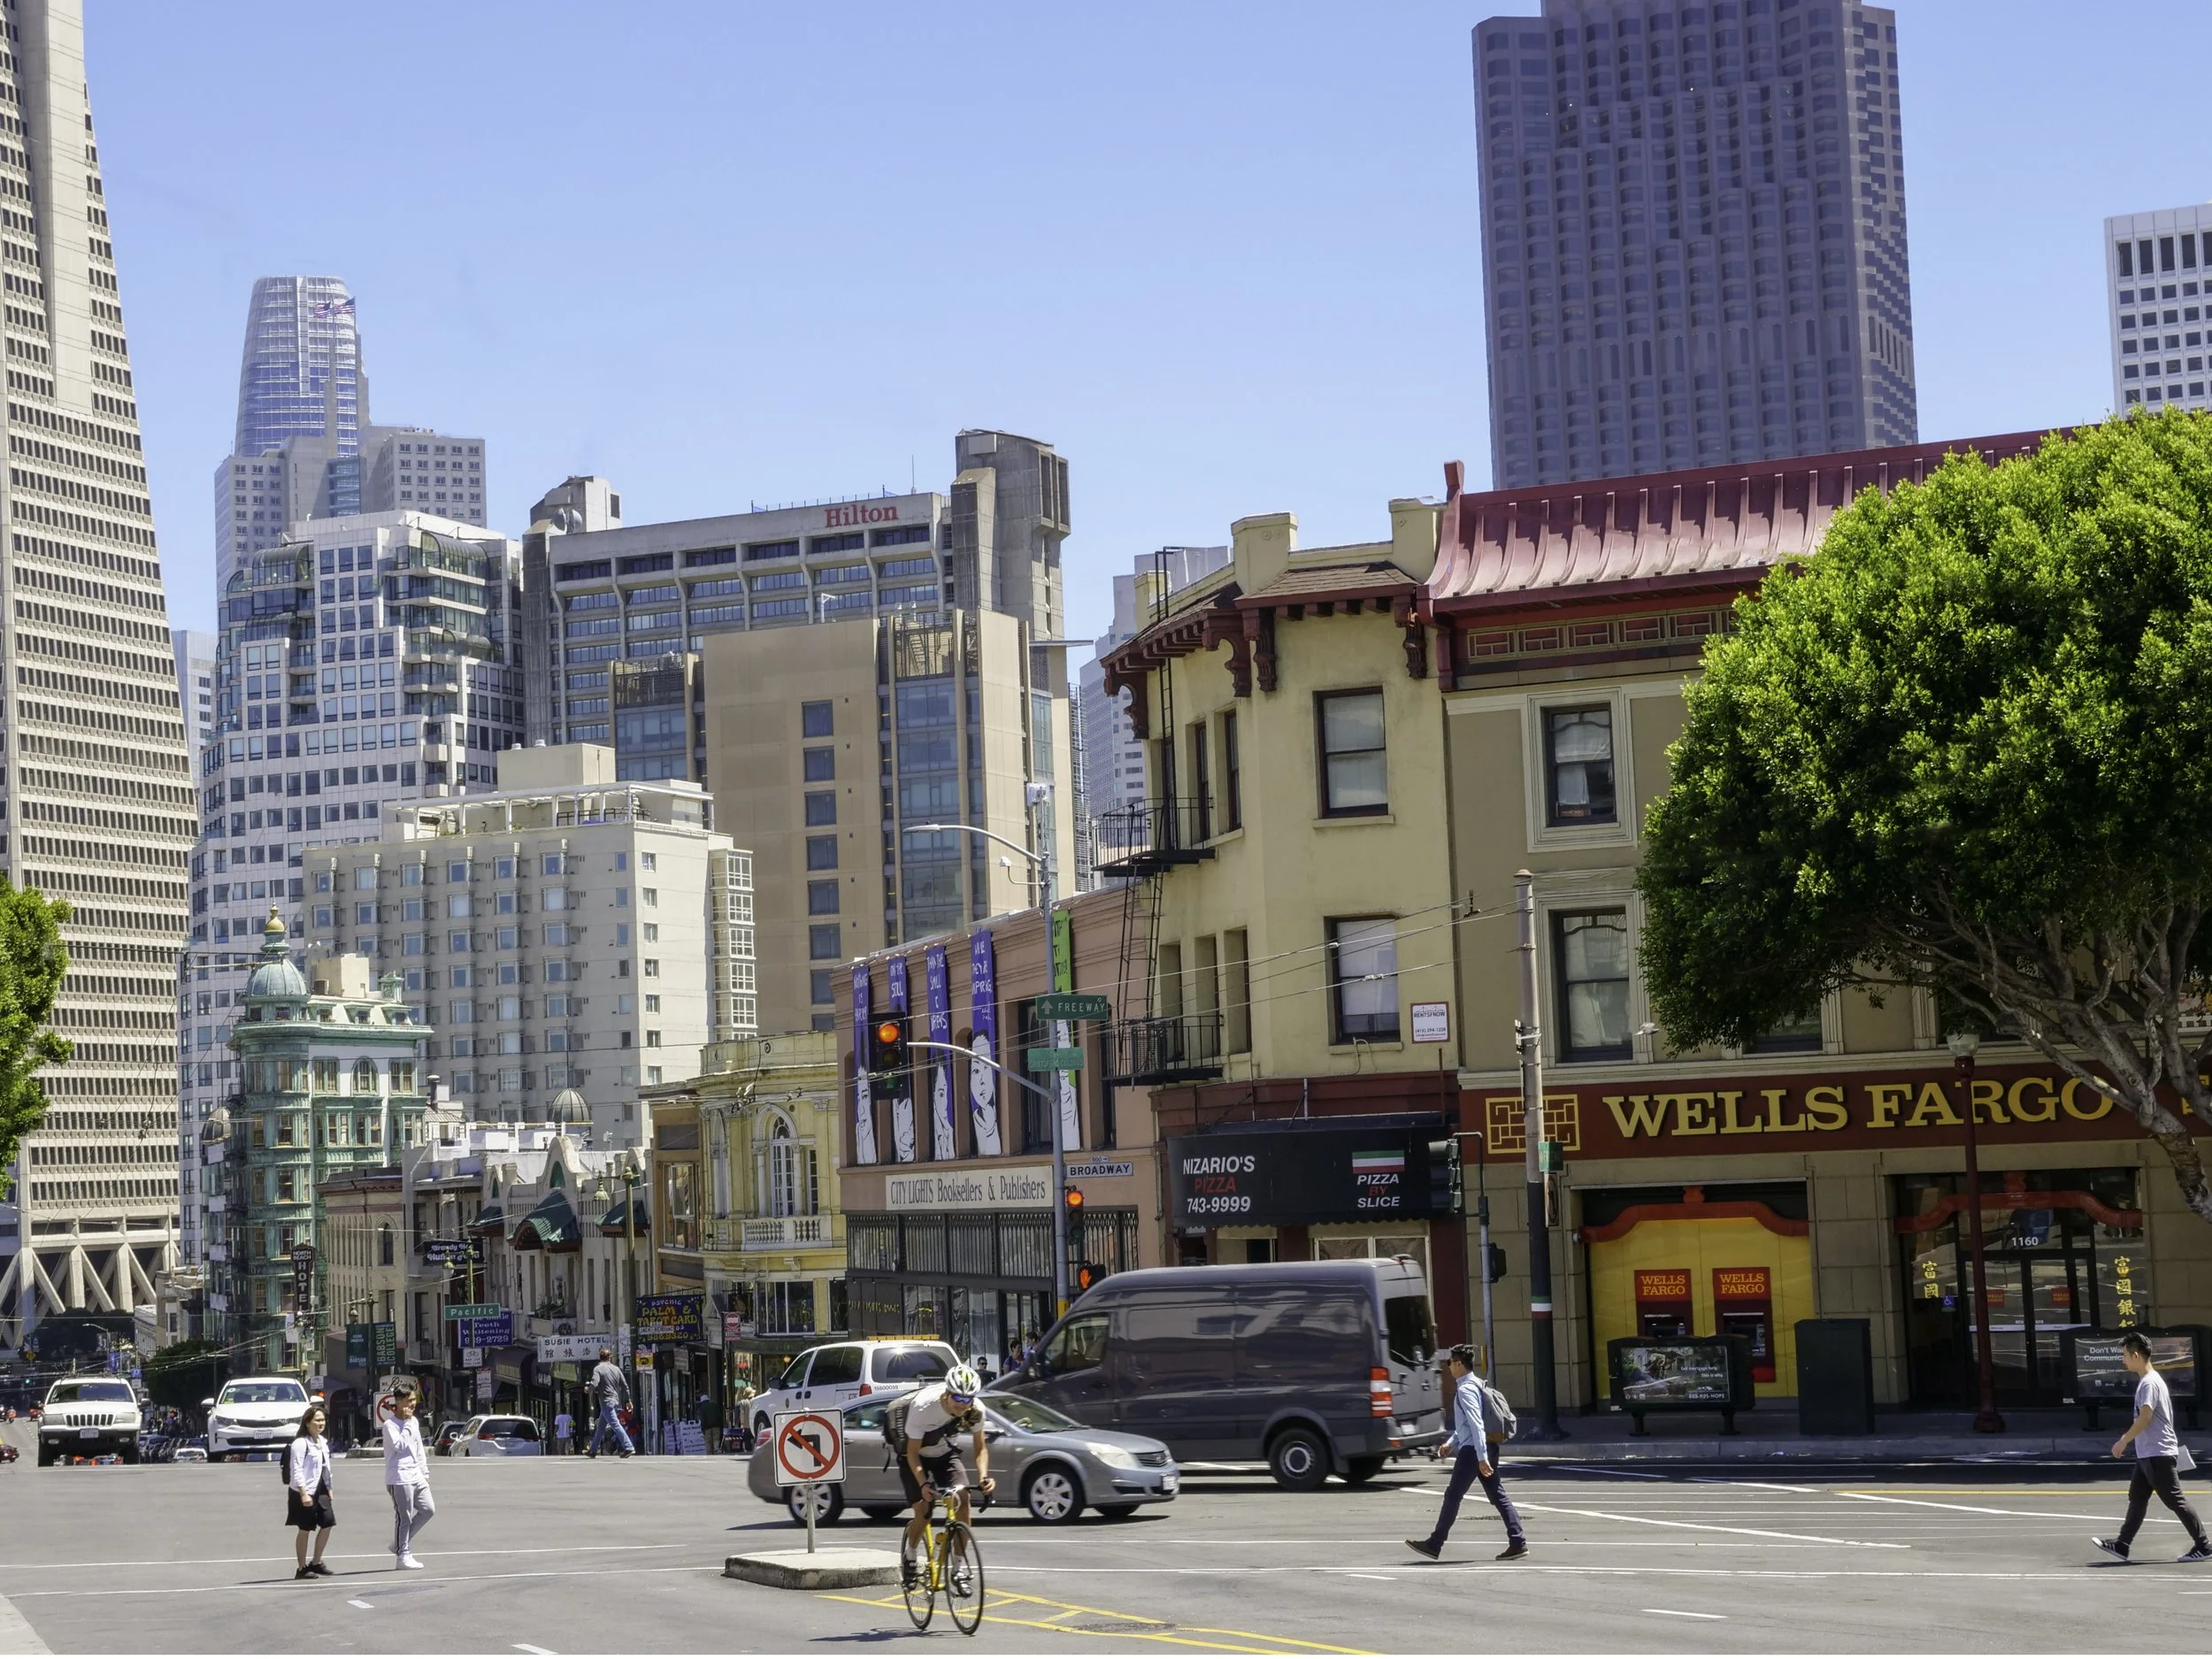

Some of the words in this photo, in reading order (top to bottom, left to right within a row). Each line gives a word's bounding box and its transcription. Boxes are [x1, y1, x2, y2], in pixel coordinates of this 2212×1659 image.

[825, 503, 898, 527] Hilton
[1057, 1002, 1105, 1012] FREEWAY
[1602, 1085, 1848, 1138] WELLS
[1863, 1077, 2113, 1127] FARGO
[1069, 1164, 1131, 1176] BROADWAY
[1183, 1155, 1256, 1175] NIZARIO'S
[1194, 1176, 1236, 1194] PIZZA
[1356, 1173, 1400, 1186] PIZZA
[890, 1180, 907, 1204] CITY
[908, 1179, 933, 1203] LIGHTS
[937, 1178, 982, 1202] Booksellers
[987, 1176, 995, 1202] &
[1000, 1174, 1046, 1201] Publishers
[1370, 1186, 1387, 1196] BY
[1187, 1196, 1251, 1213] 743-9999
[1357, 1196, 1401, 1208] SLICE
[2011, 1236, 2039, 1246] 1160
[1640, 1274, 1686, 1285] WELLS
[1718, 1272, 1764, 1283] WELLS
[1642, 1285, 1686, 1295] FARGO
[1721, 1283, 1764, 1294] FARGO
[641, 1306, 676, 1317] PALM
[682, 1305, 692, 1314] &
[671, 1315, 698, 1325] CARD
[375, 1327, 387, 1362] BABSON
[386, 1325, 396, 1362] COLLEGE
